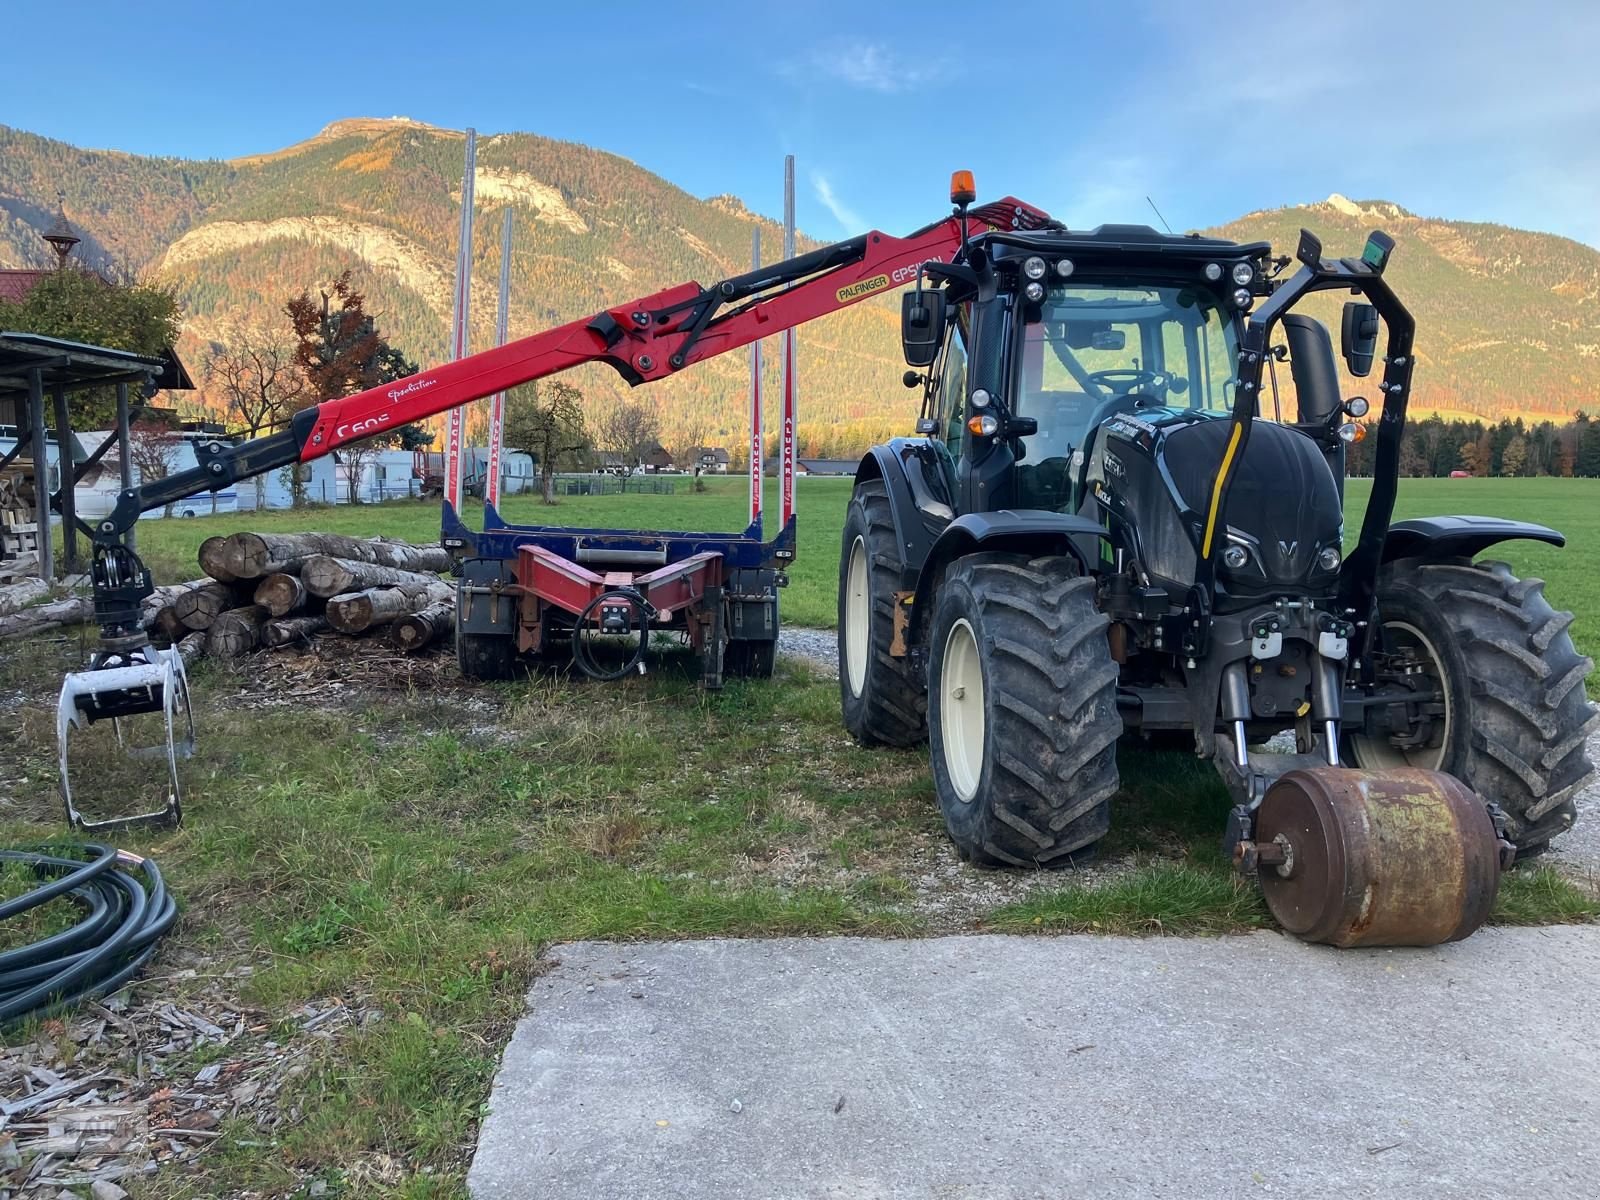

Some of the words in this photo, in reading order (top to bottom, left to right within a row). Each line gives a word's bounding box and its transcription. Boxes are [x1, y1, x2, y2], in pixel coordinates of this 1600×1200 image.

[838, 275, 887, 300] PALFINGER
[449, 407, 460, 457] LUCAR
[784, 417, 792, 474] ALUCAR
